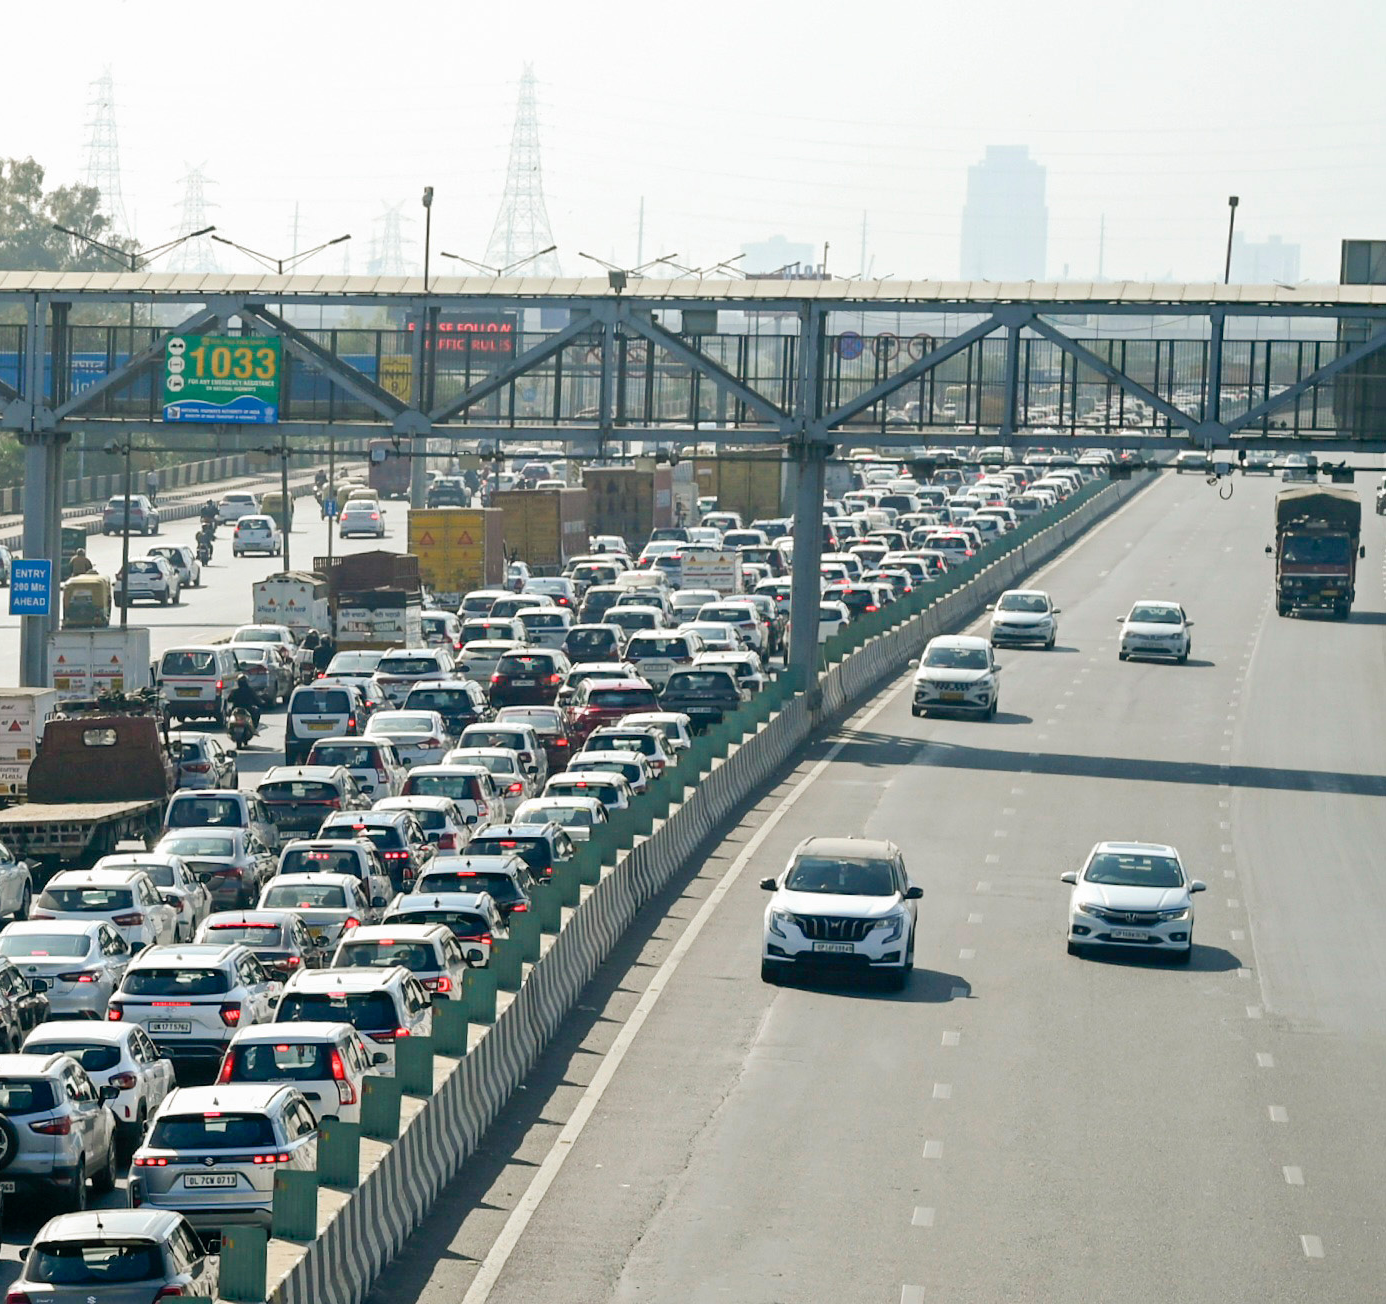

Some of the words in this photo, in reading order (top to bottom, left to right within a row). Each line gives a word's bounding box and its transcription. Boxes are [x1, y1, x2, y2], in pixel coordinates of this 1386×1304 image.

[189, 347, 276, 379] 1033
[15, 569, 46, 579] ENTRY
[14, 597, 46, 606] AHEAD
